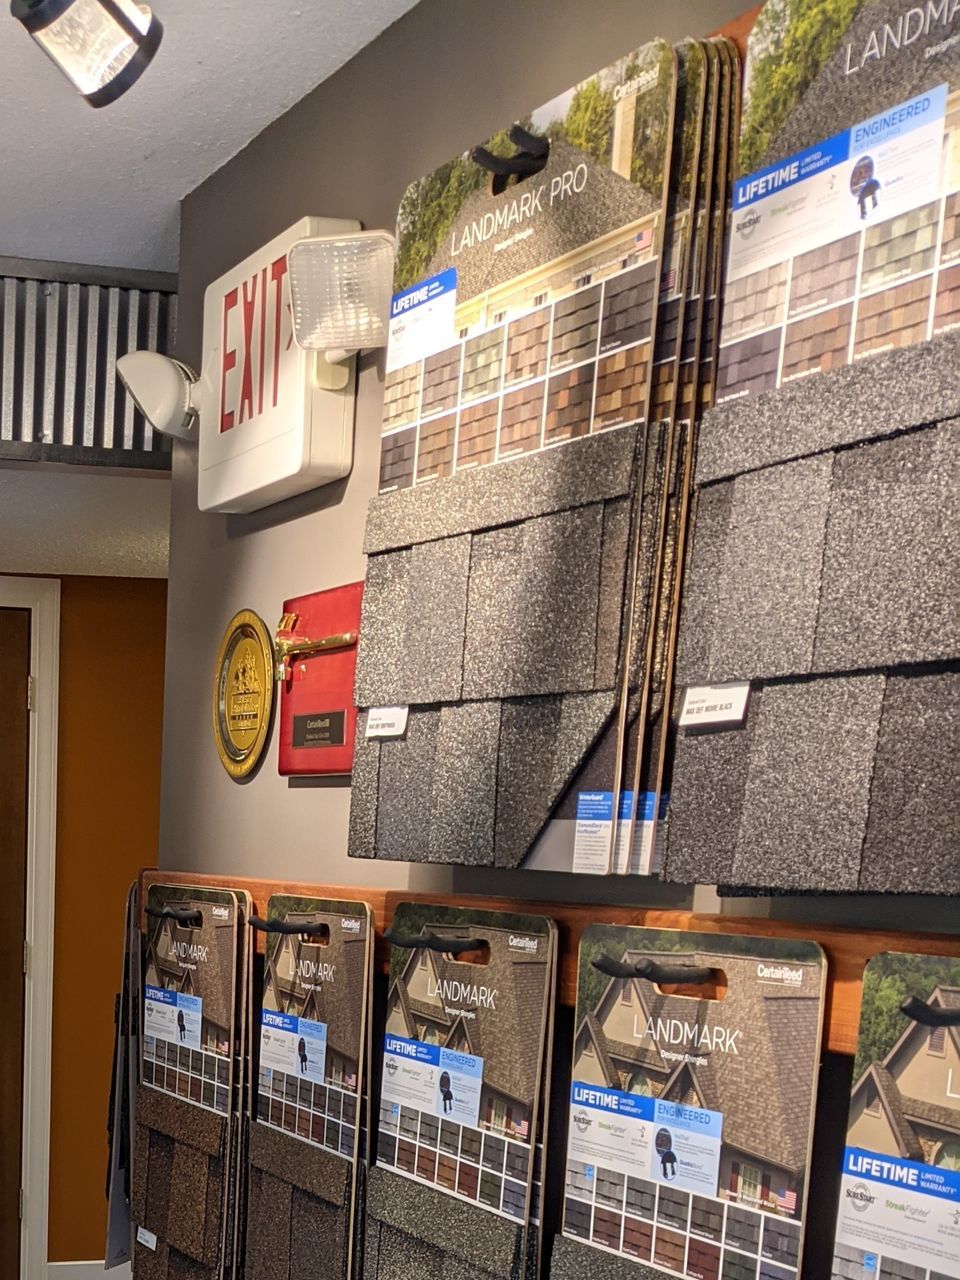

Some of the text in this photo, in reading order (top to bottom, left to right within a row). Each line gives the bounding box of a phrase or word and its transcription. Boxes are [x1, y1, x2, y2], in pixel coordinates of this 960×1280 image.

[855, 98, 931, 143] ENGINEERED
[738, 160, 801, 203] LIFETIME
[451, 163, 587, 257] LANDMARK PRO
[393, 285, 429, 315] LIFETIME
[220, 253, 288, 435] EXIT
[508, 935, 538, 949] CertainTeed
[290, 958, 335, 983] LANDMARK
[757, 964, 803, 981] CertainTeed
[427, 977, 497, 1009] LANDMARK
[263, 1013, 283, 1027] LIFETIME
[633, 1014, 740, 1055] LANDMARK
[386, 1039, 416, 1056] LIFETIME
[660, 1049, 708, 1067] Designer Shingles
[442, 1051, 476, 1068] ENGINEERED
[574, 1087, 619, 1110] LIFETIME
[657, 1103, 711, 1126] ENGINEERED
[848, 1154, 919, 1187] LIFETIME
[921, 1171, 945, 1183] LIMITED
[920, 1179, 957, 1195] WARRANTY
